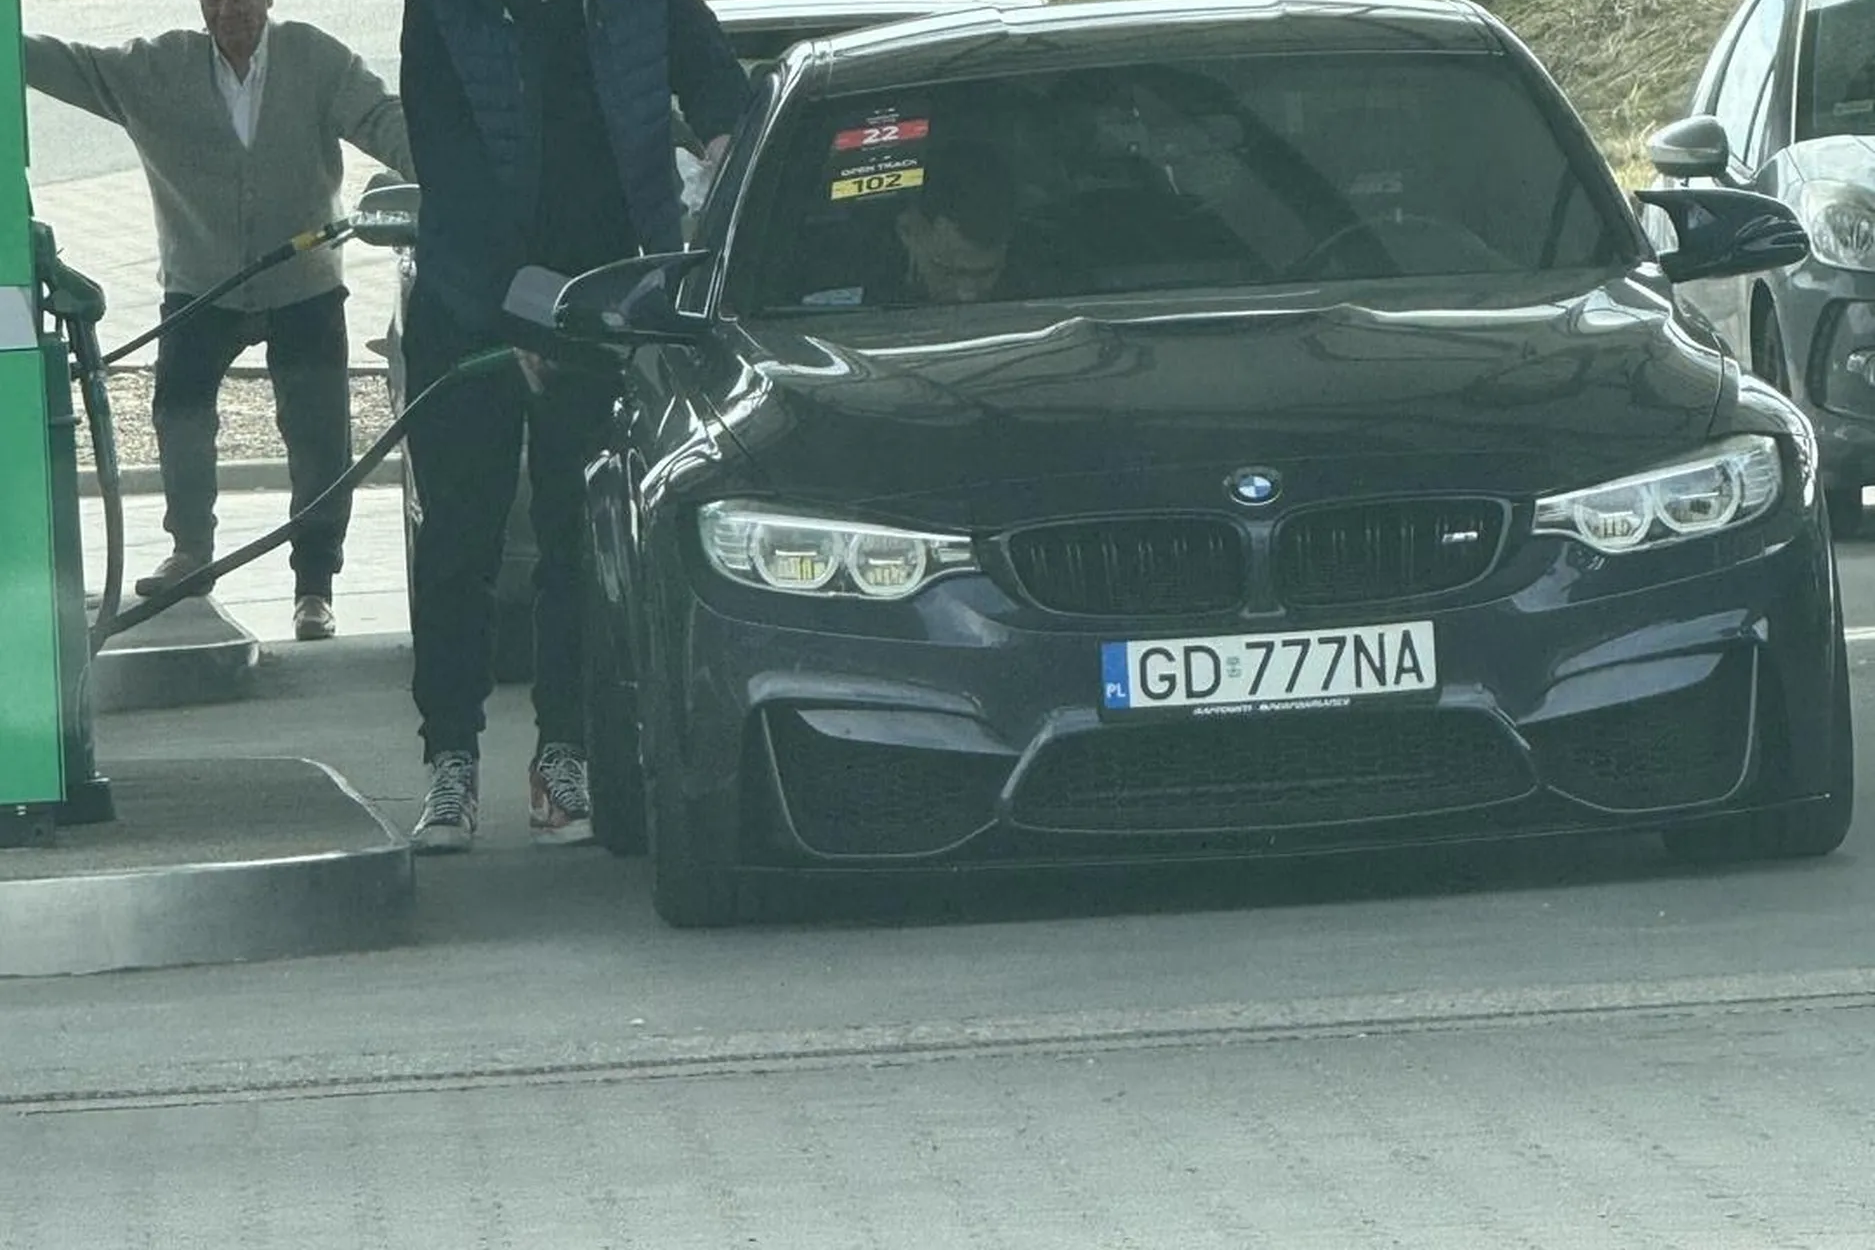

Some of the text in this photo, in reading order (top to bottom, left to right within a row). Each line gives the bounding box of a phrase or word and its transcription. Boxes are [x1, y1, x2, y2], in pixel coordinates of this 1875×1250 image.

[862, 126, 900, 144] 22
[877, 159, 917, 171] TRACK
[852, 173, 902, 193] 102
[1139, 630, 1425, 700] GD 777NA
[1106, 682, 1126, 698] PL
